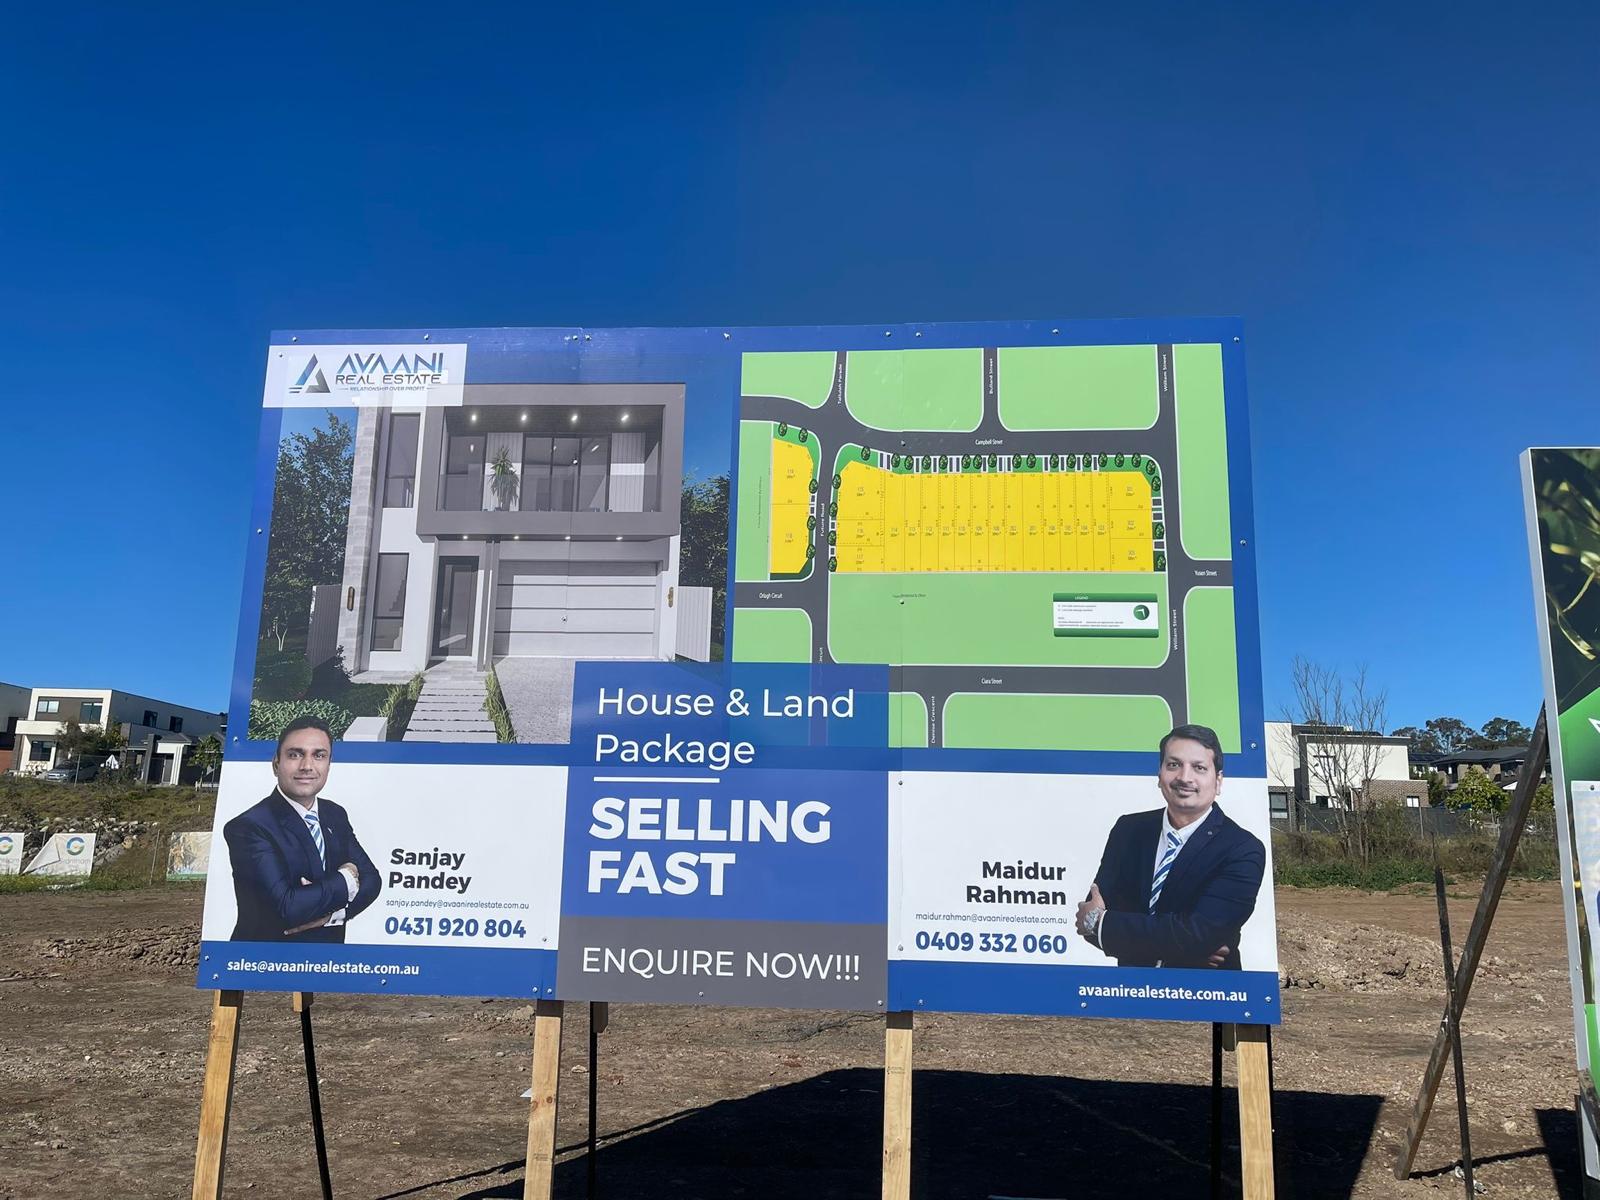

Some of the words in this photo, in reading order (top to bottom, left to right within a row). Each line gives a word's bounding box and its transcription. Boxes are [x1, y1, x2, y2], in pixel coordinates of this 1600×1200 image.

[336, 352, 444, 374] AVAANI
[335, 374, 376, 385] REAL
[382, 373, 442, 385] ESTATE
[598, 687, 714, 716] House
[726, 688, 750, 716] &
[763, 688, 854, 718] Land
[595, 733, 755, 771] Package
[588, 797, 831, 844] SELLING
[390, 847, 466, 870] Sanjay
[587, 850, 736, 896] FAST
[982, 860, 1066, 880] Maidur
[388, 871, 472, 894] Pandey
[386, 898, 530, 910] sanjay.pandey@avaanirealestate.com.au
[966, 885, 1066, 905] Rahman
[384, 916, 433, 936] 0431
[438, 918, 479, 937] 920
[484, 919, 527, 938] 804
[915, 911, 1068, 924] maidur.rahman@avaanirealestate.com.au
[915, 931, 974, 951] 0409
[979, 932, 1017, 953] 332
[1023, 934, 1067, 954] 060
[227, 959, 419, 976] sales@avaanirealestate.com.au
[582, 947, 734, 979] ENQUIRE
[746, 951, 860, 981] NOW!!!
[1078, 983, 1247, 1002] avaanirealestate.com.au
